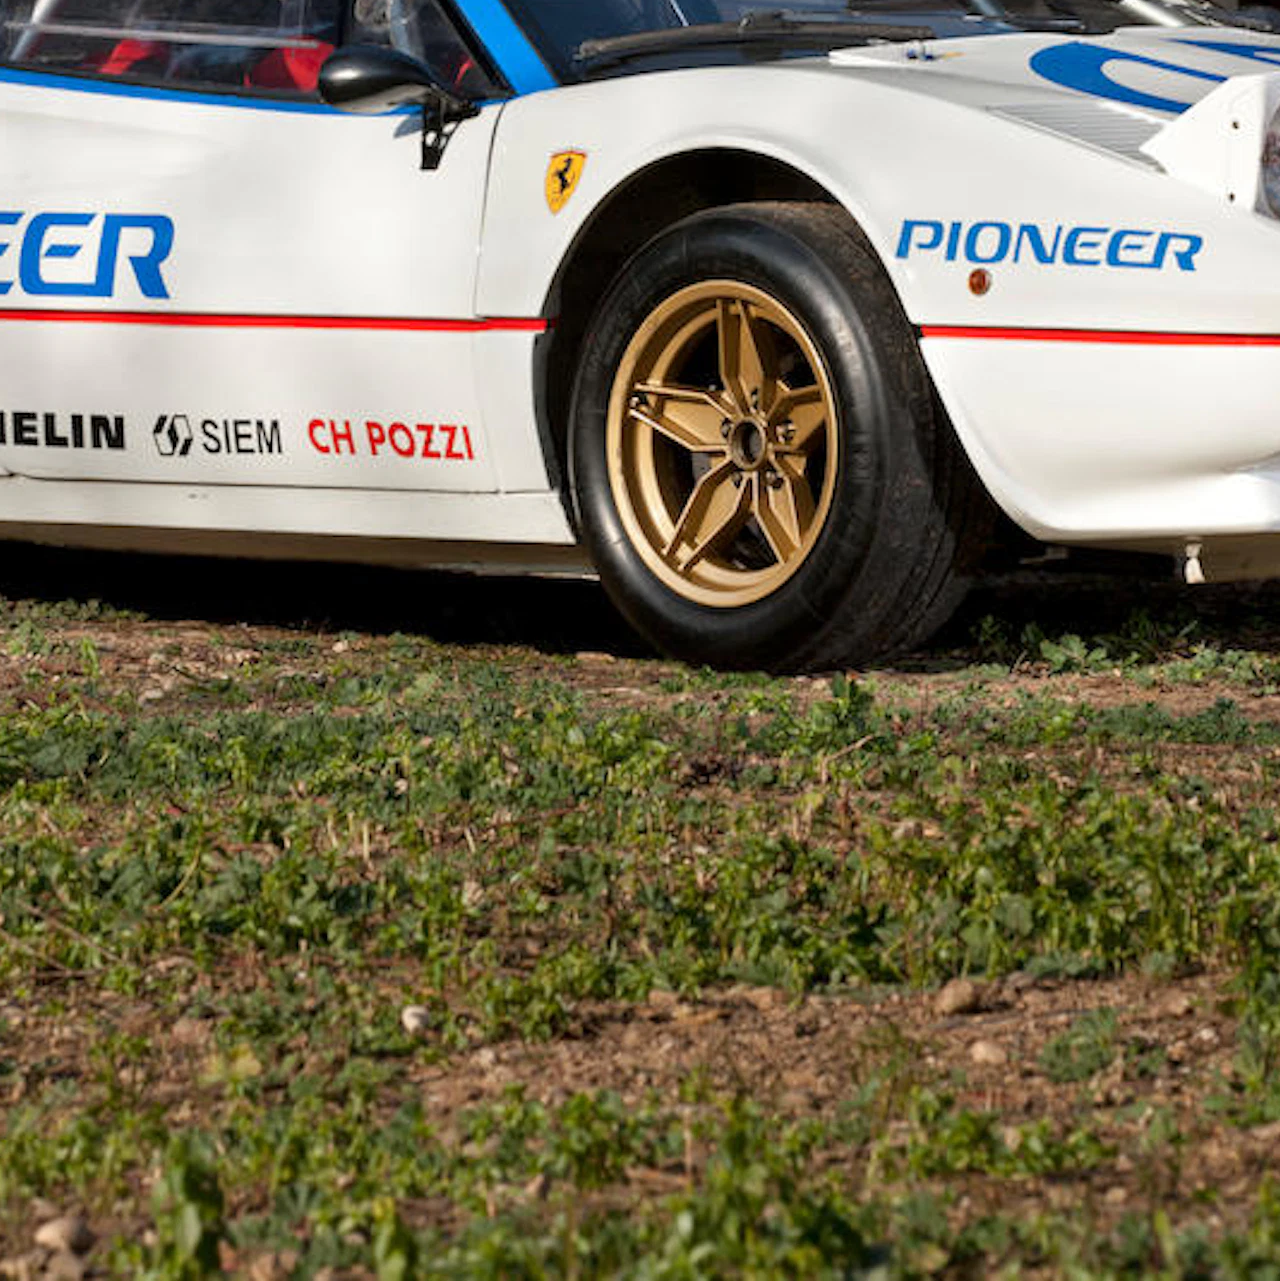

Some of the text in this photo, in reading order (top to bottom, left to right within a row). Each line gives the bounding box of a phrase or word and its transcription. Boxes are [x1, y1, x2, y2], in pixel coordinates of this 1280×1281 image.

[896, 219, 1203, 271] PIONEER
[201, 419, 282, 454] SIEM
[308, 419, 356, 455] CH
[365, 420, 475, 461] POZZI
